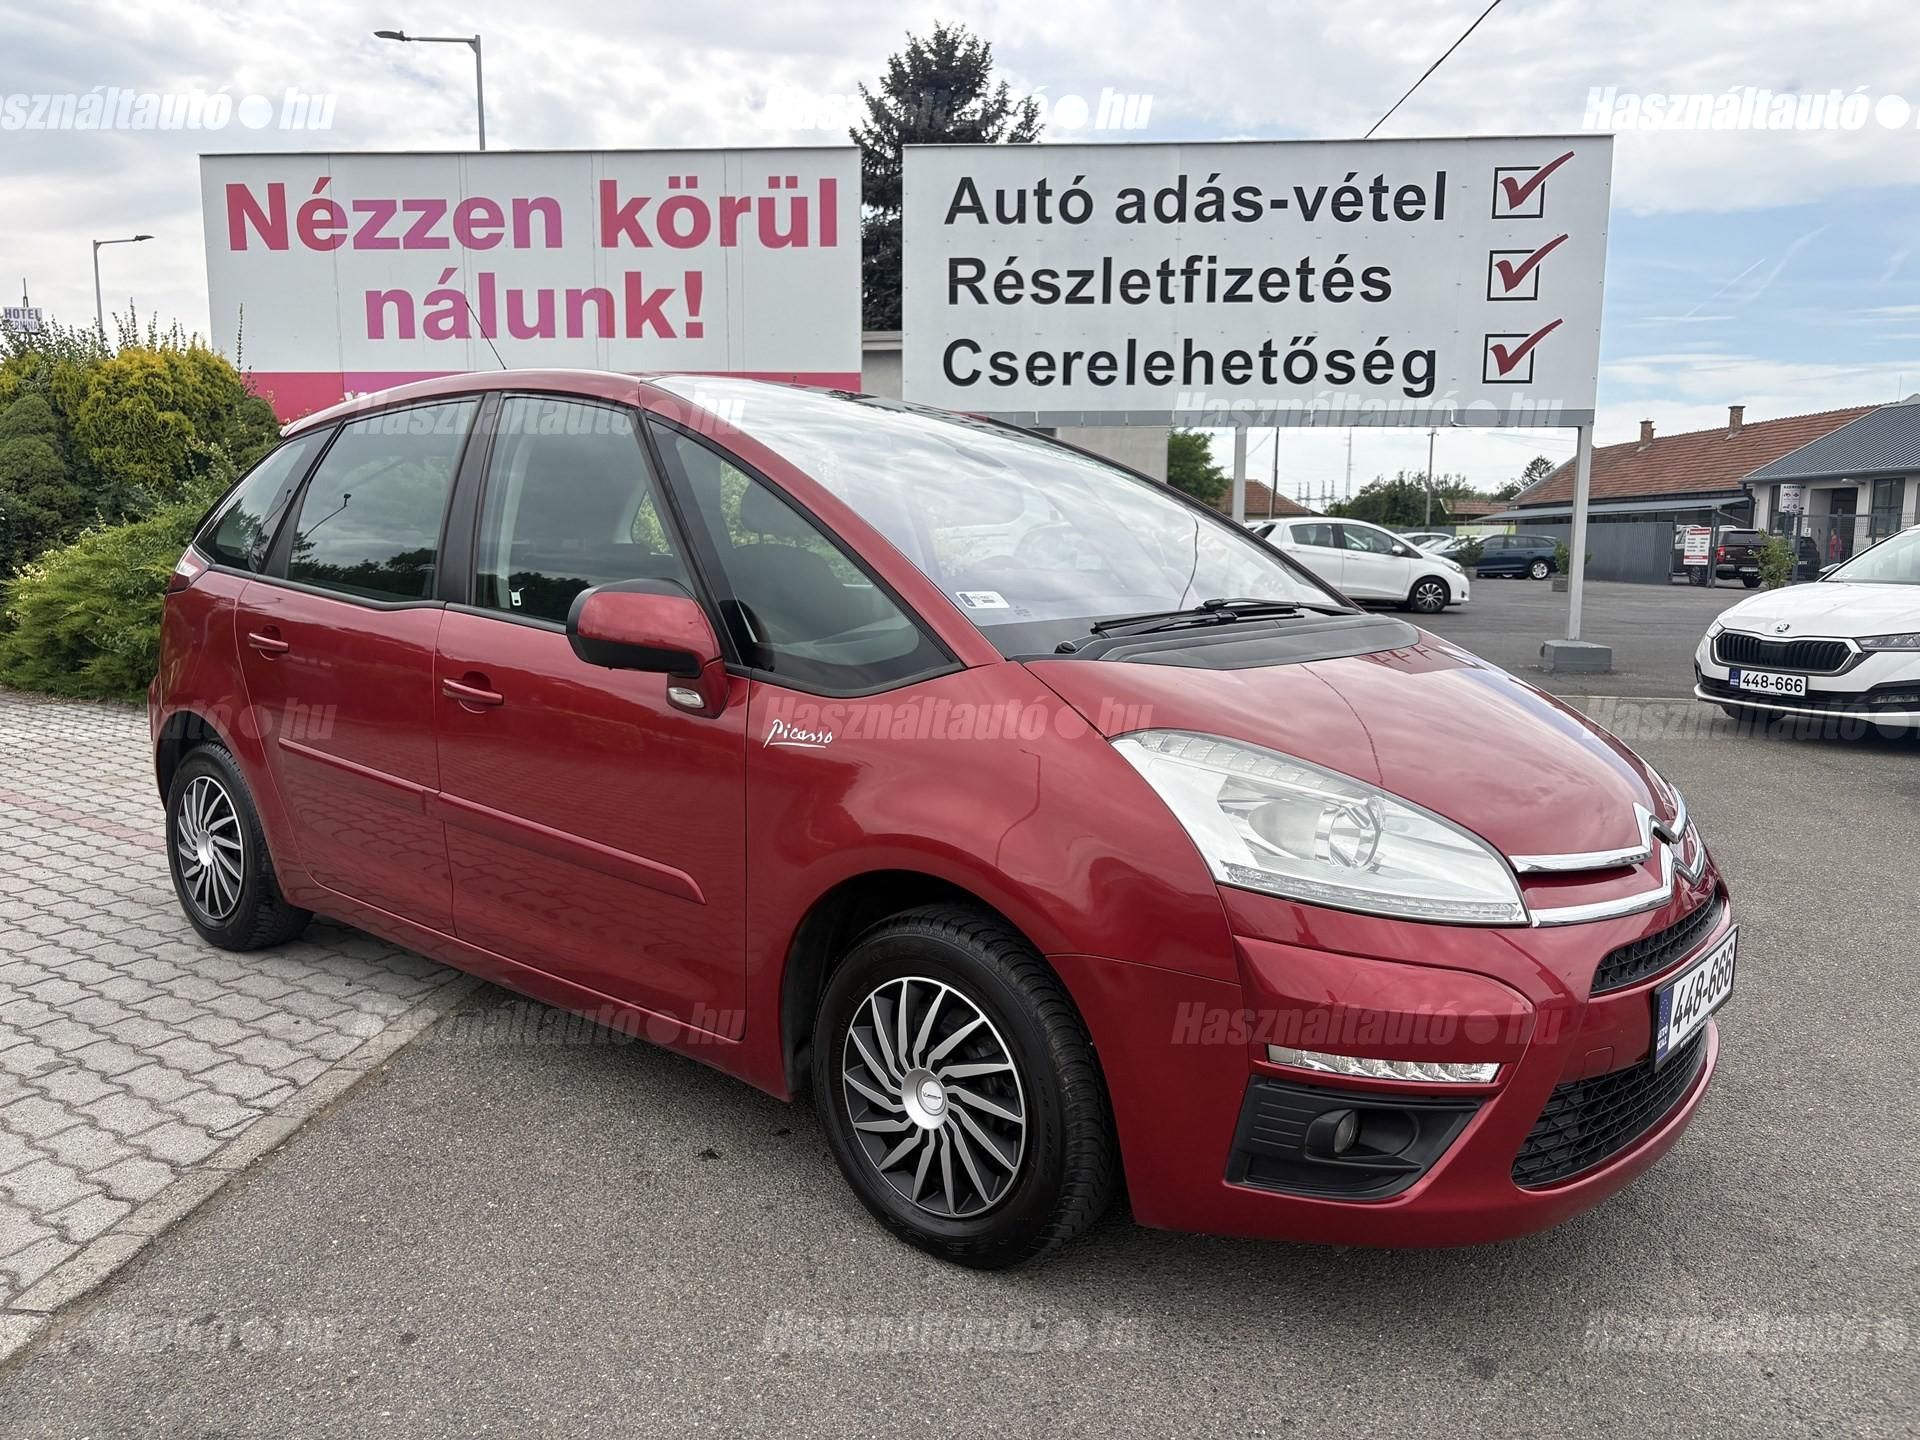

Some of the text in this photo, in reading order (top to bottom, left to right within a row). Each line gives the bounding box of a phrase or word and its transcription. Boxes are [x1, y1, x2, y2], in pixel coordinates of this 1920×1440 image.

[227, 176, 837, 251] Nézzen körül
[945, 171, 1446, 225] Autó adás-vétel
[366, 268, 704, 340] nálunk!
[948, 254, 1391, 305] Részletfizetés
[4, 308, 42, 320] HOTEL
[943, 335, 1436, 399] Cserelehetőség
[1742, 673, 1803, 693] 448-666
[763, 719, 833, 749] Picasso
[1672, 942, 1734, 1034] 448-666
